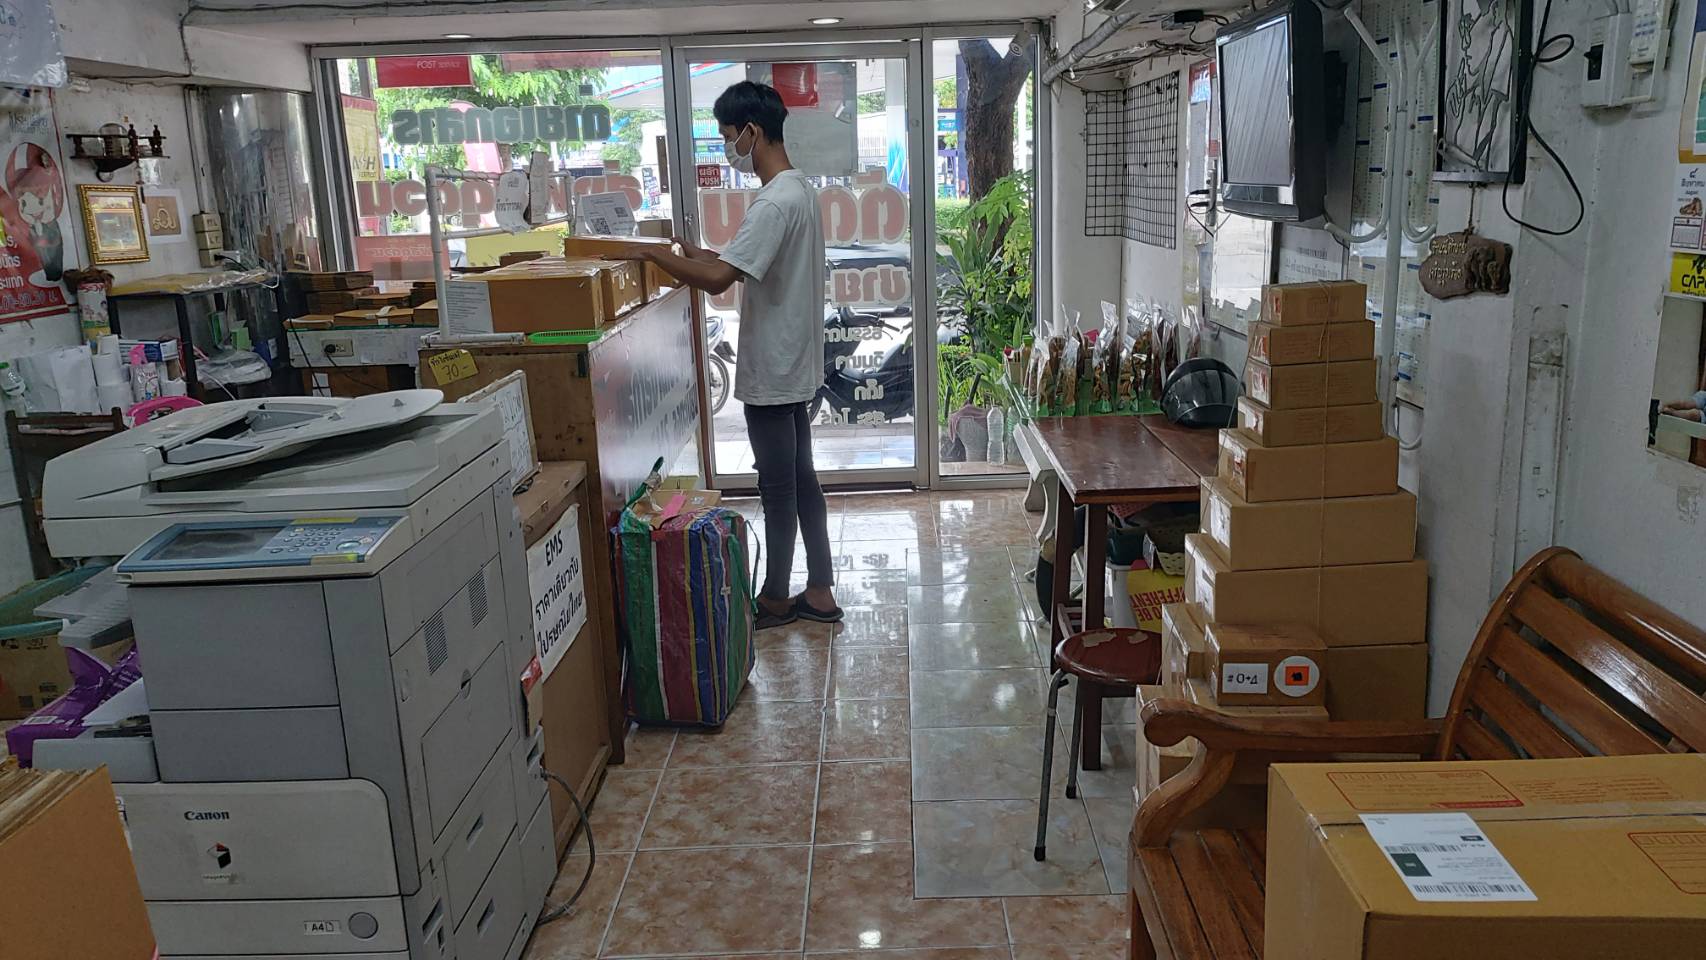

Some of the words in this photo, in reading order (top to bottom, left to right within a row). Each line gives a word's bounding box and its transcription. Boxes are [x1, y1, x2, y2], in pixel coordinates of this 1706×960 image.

[699, 177, 720, 186] PUSH
[1682, 274, 1706, 289] CAP
[545, 530, 563, 567] EMS
[535, 557, 579, 621] ราคาเดียวกับ
[184, 810, 230, 821] Canon
[311, 923, 325, 932] A4
